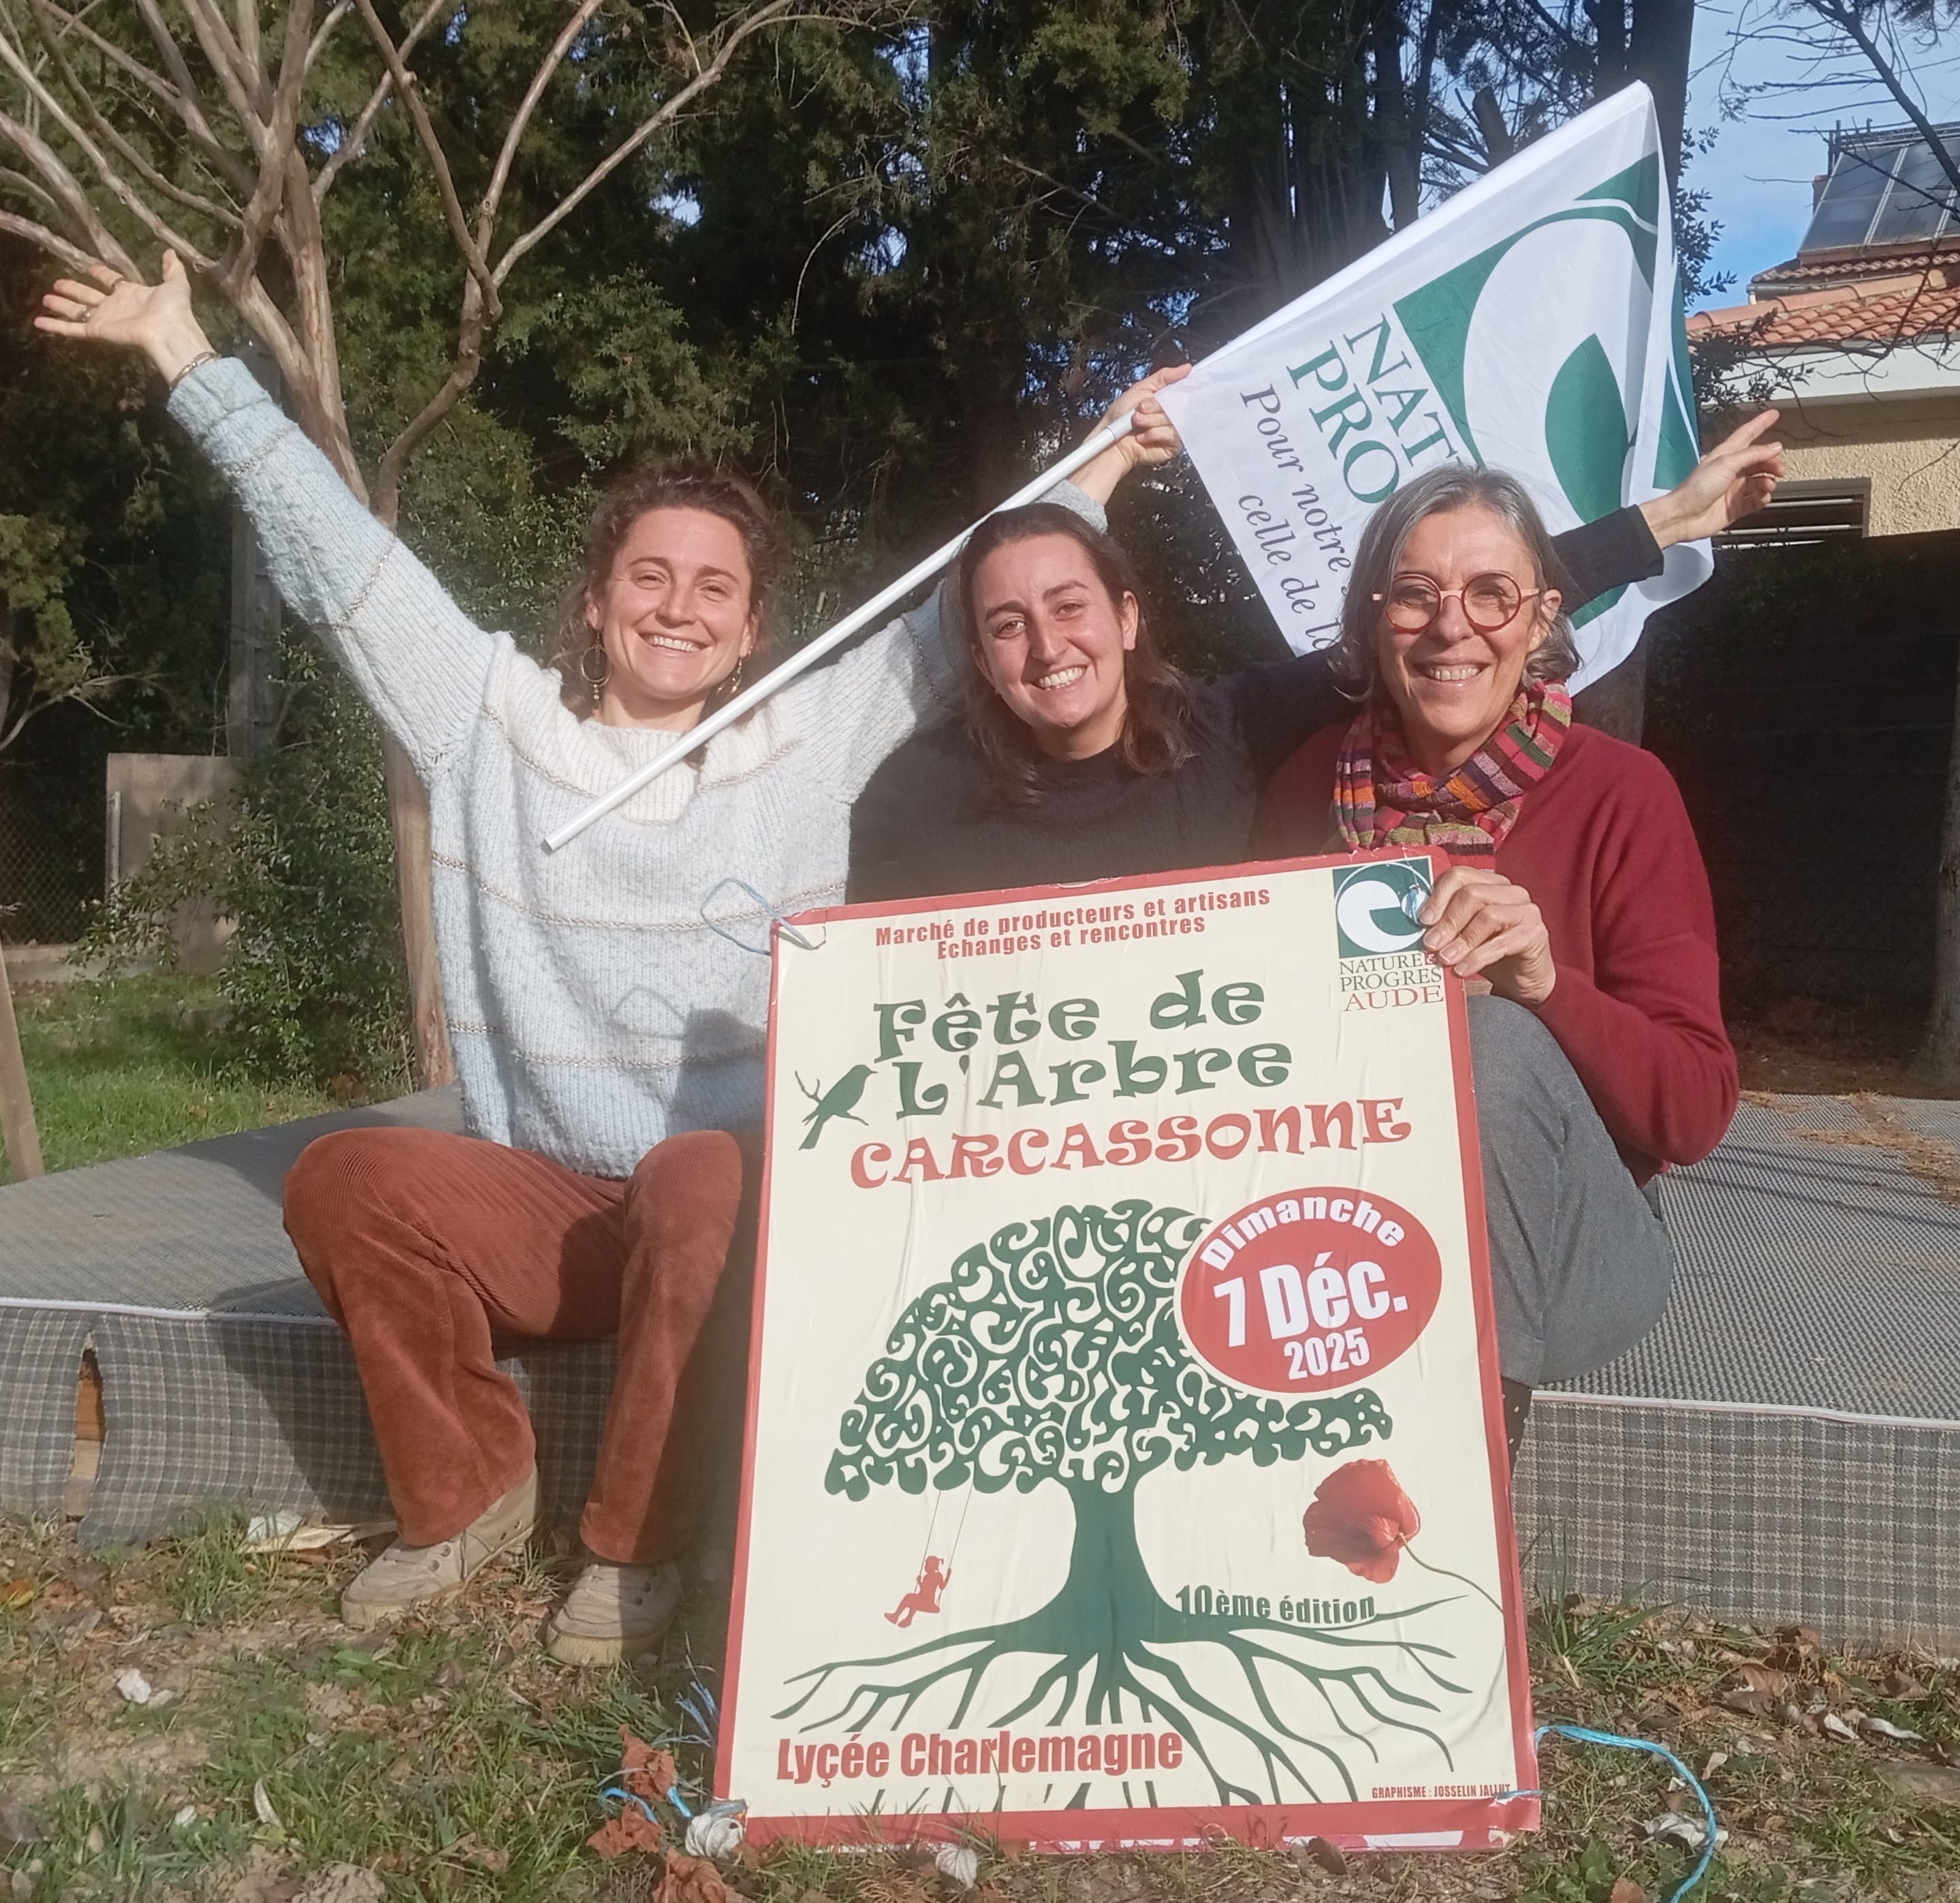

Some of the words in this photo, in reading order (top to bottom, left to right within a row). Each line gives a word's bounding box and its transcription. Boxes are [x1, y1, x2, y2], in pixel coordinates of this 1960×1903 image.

[1344, 313, 1462, 467] NAT
[1240, 383, 1303, 473] Pour
[1292, 483, 1352, 573] notre
[1238, 494, 1296, 566] celle
[1280, 578, 1320, 614] de
[876, 919, 954, 946] Marché
[964, 917, 990, 937] de
[998, 903, 1135, 935] producteurs
[1143, 898, 1165, 917] et
[1174, 889, 1270, 914] artisans
[938, 934, 1042, 960] Echanges
[1050, 930, 1072, 948] et
[1080, 917, 1205, 945] rencontres
[1339, 953, 1423, 975] NATURE
[873, 990, 1100, 1063] Fête
[1150, 969, 1264, 1030] de
[1344, 985, 1444, 1011] AUDE
[892, 1040, 1292, 1120] L'Arbre
[851, 1097, 1411, 1189] CARCASSONNE
[1200, 1196, 1406, 1272] Dimanche
[1213, 1277, 1246, 1348] 7
[1259, 1251, 1408, 1340] Déc.
[1283, 1327, 1370, 1380] 2025
[1175, 1584, 1271, 1618] 10ème
[1280, 1594, 1376, 1624] édition
[900, 1730, 1184, 1776] Charlemagne
[1372, 1786, 1427, 1799] GRAPHISME
[1434, 1784, 1477, 1798] JOSSELIN
